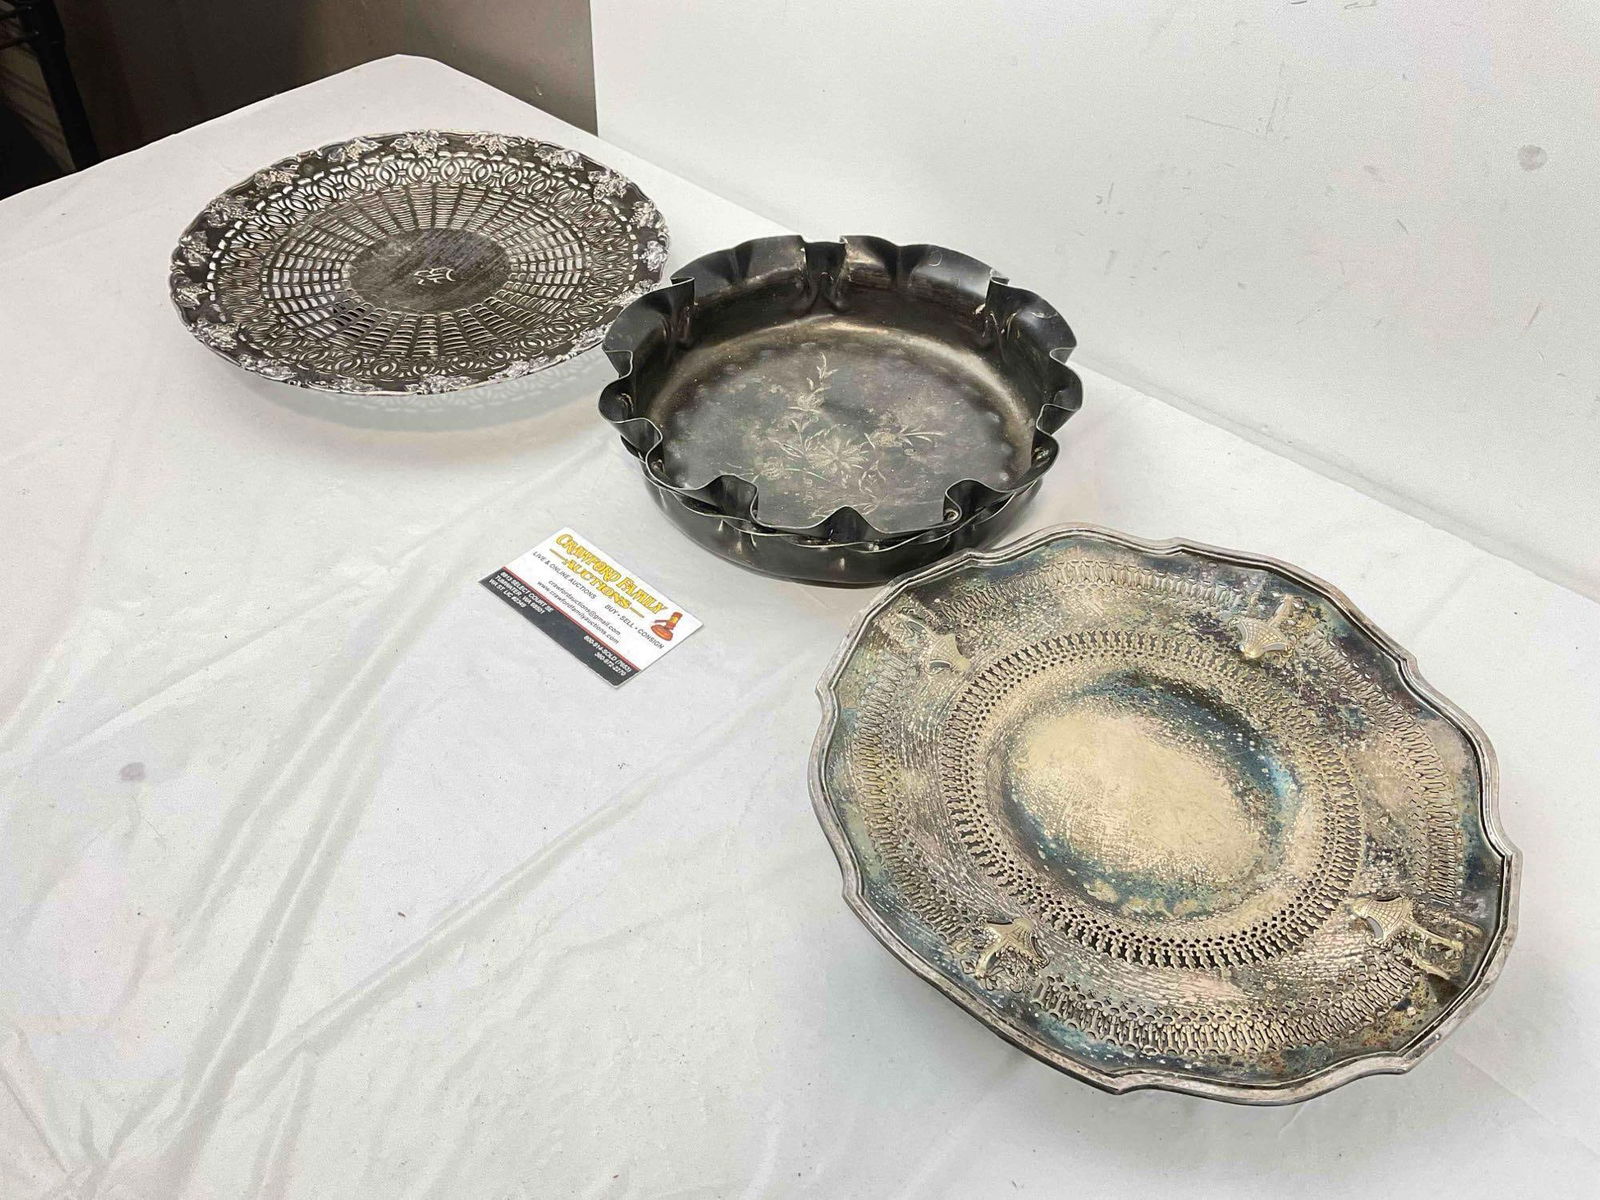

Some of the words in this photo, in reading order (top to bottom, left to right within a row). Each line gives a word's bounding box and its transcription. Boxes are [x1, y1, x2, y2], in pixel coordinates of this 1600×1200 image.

[510, 579, 531, 594] SELECT
[528, 592, 547, 606] COURT
[532, 551, 545, 561] LIVE
[549, 563, 570, 579] ONLINE
[568, 578, 596, 599] AUCTIONS
[555, 534, 621, 582] CRAWFORD
[615, 576, 666, 614] FAMILY
[564, 559, 631, 608] AUCTIONS
[604, 604, 618, 614] BUY
[619, 615, 633, 627] SELL
[637, 628, 664, 649] CONSIGN
